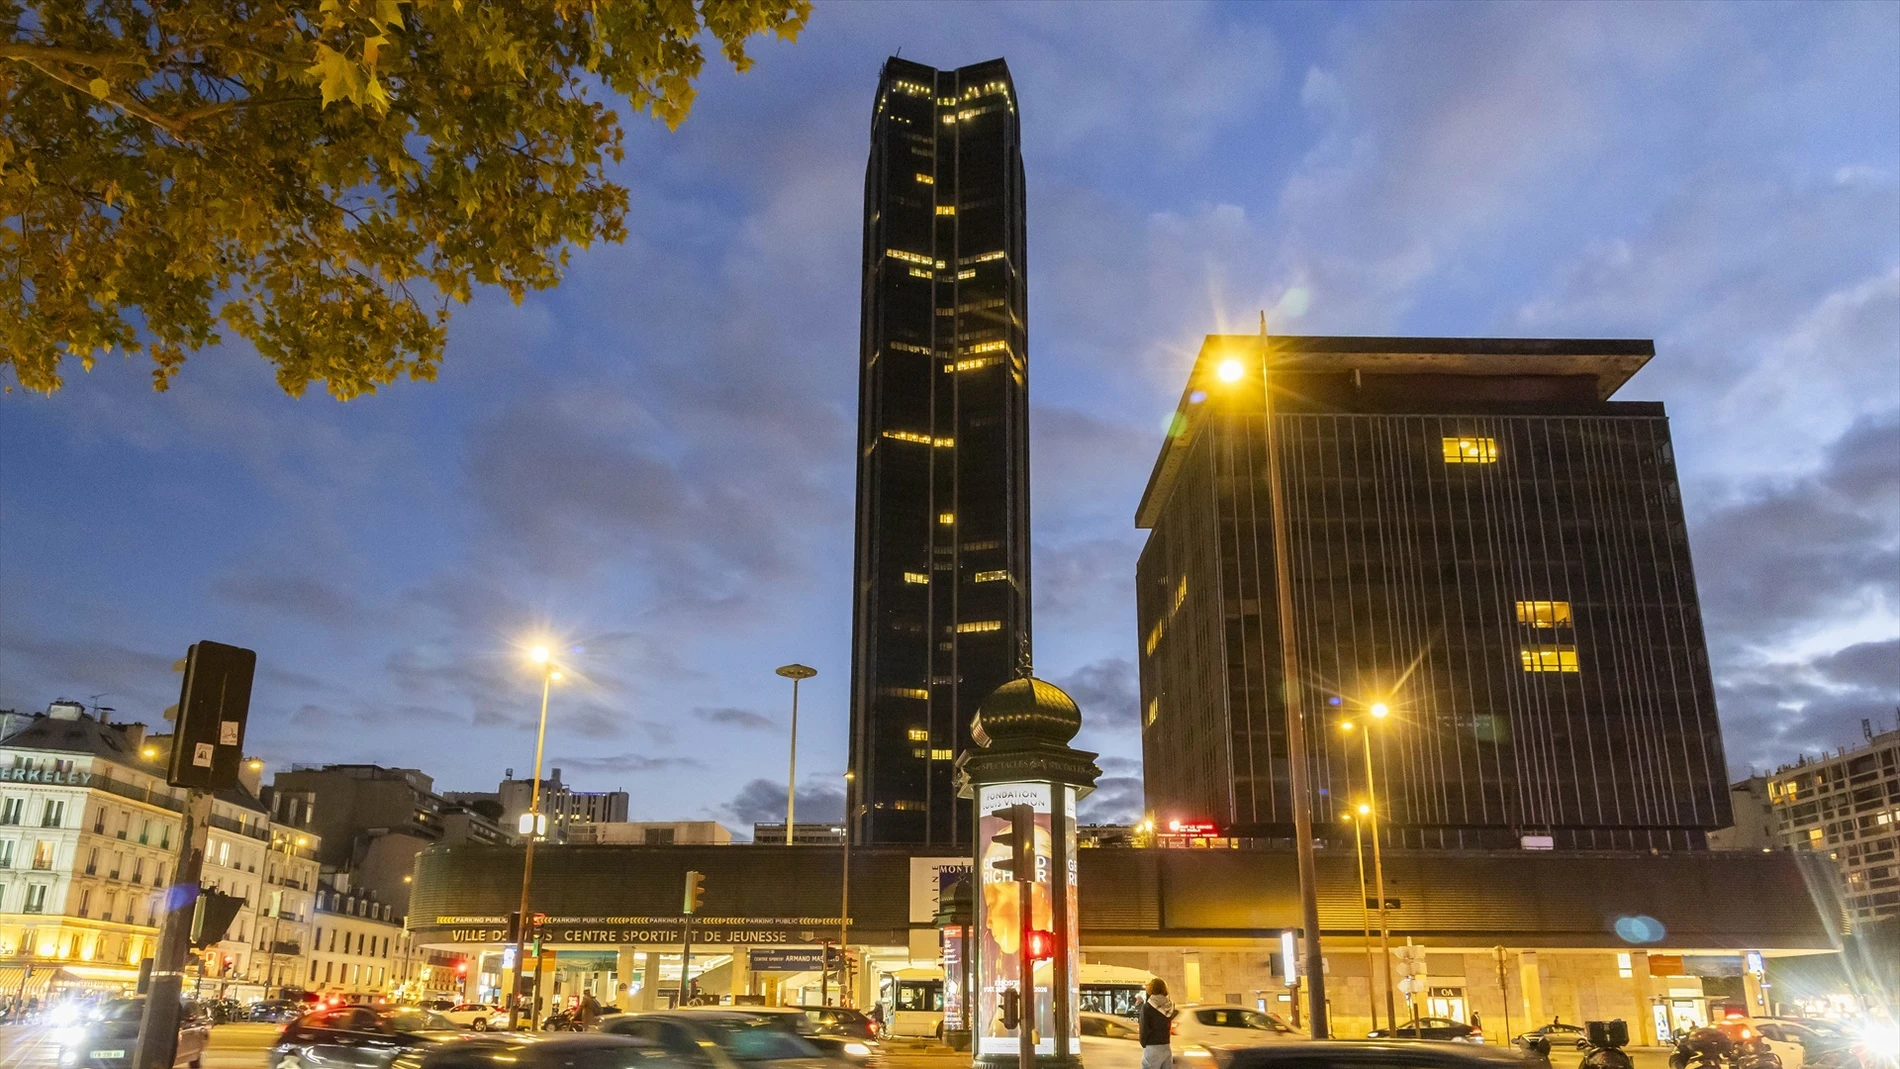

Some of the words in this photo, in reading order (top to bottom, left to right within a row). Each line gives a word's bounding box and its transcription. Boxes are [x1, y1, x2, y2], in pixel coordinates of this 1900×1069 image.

[987, 791, 1037, 800] FONDATION
[983, 870, 1047, 884] RICHR
[452, 930, 486, 941] VILLE
[564, 930, 617, 942] CENTRE
[622, 930, 678, 942] SPORTIF
[704, 931, 721, 942] DE
[726, 931, 787, 942] JEUNESSE
